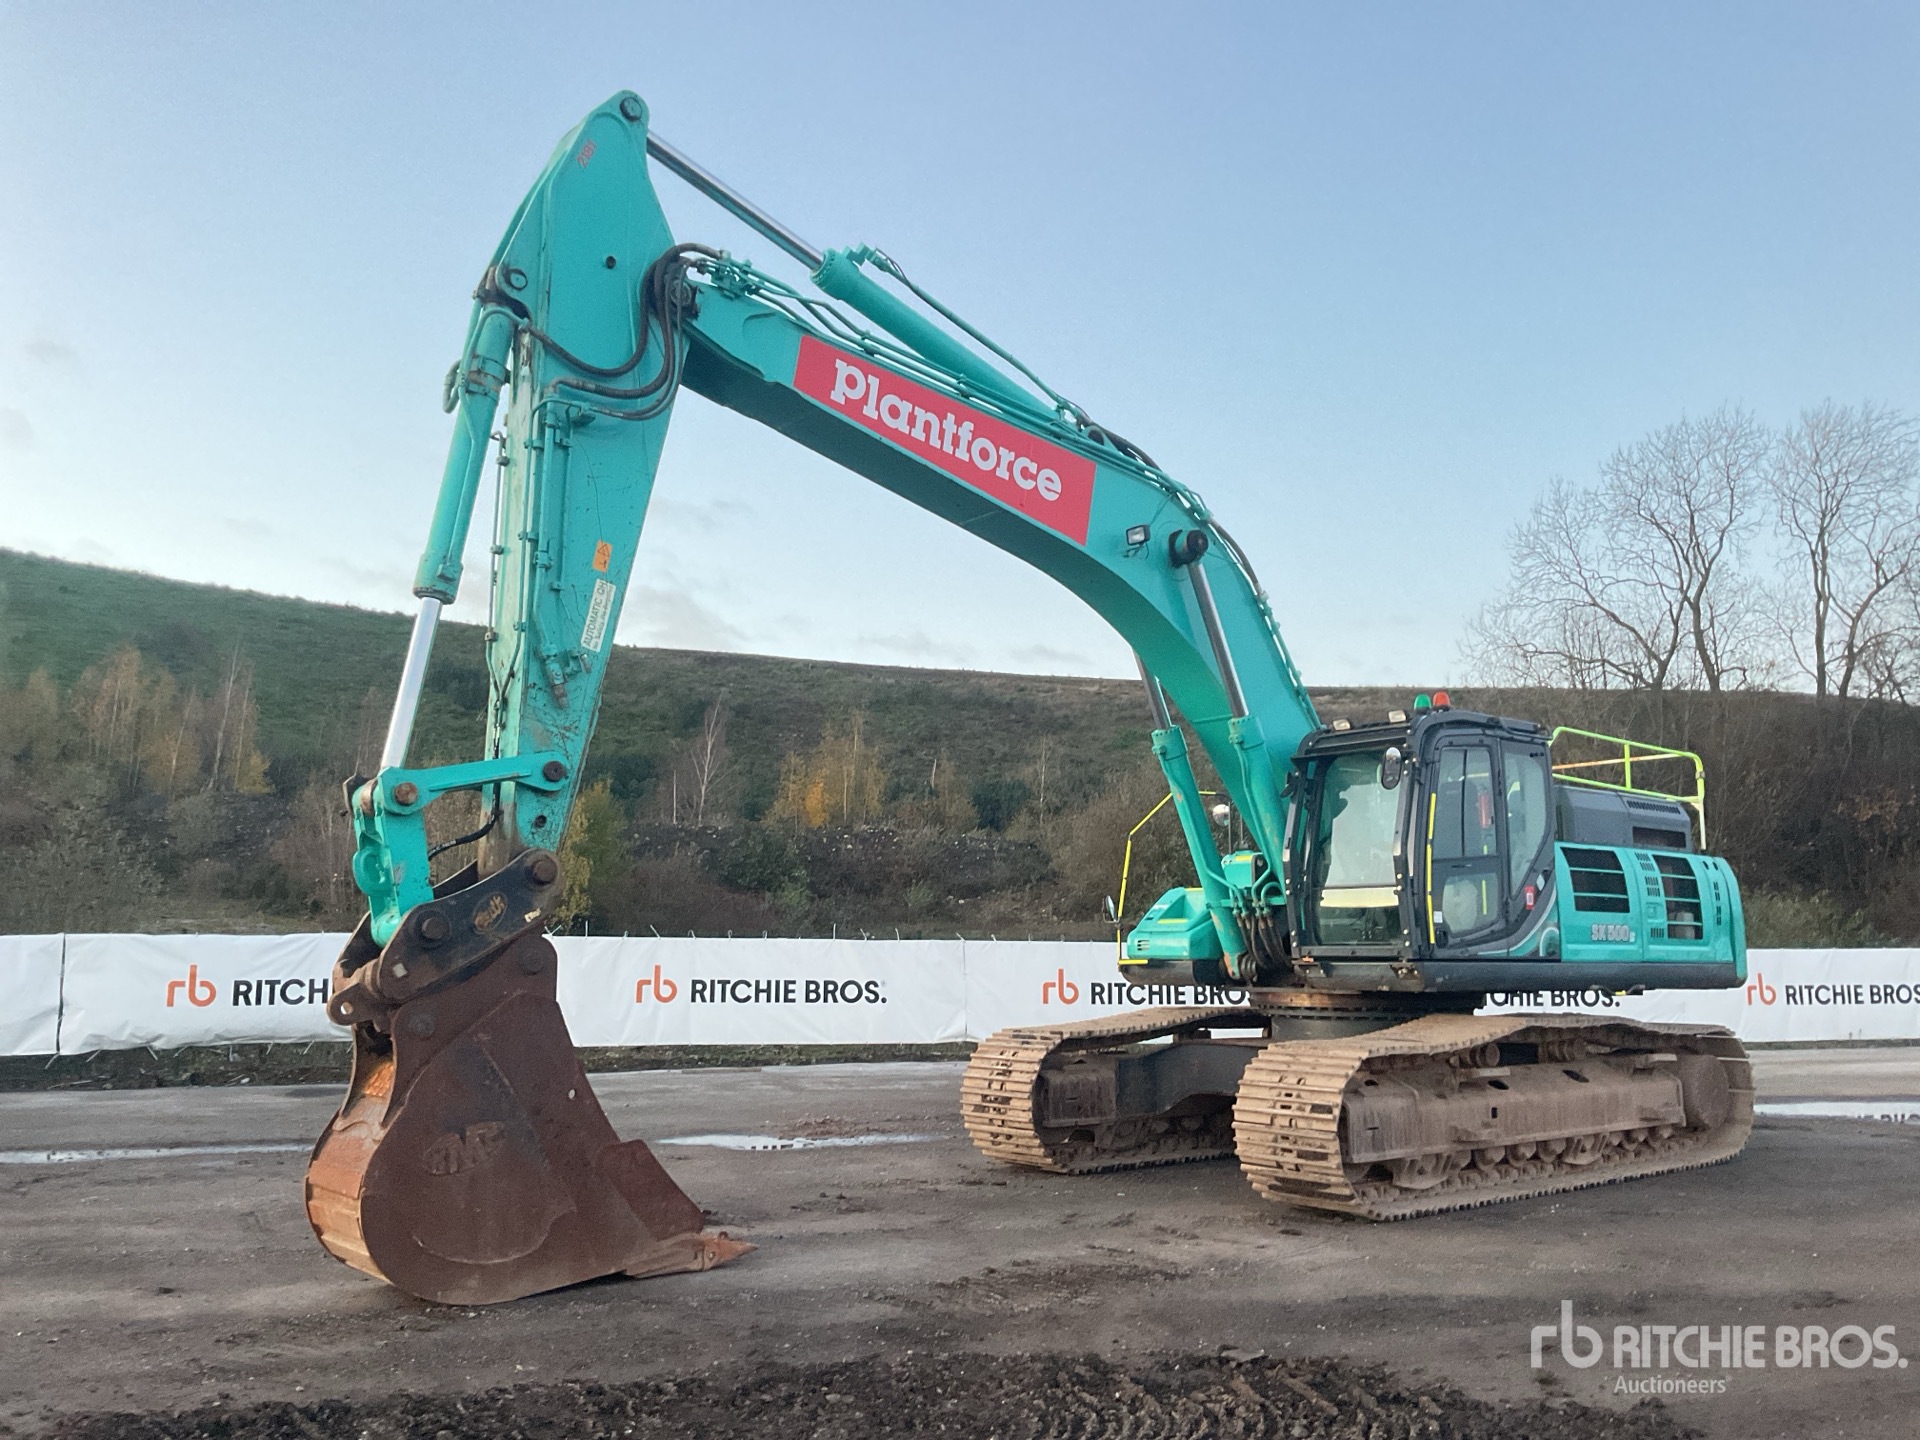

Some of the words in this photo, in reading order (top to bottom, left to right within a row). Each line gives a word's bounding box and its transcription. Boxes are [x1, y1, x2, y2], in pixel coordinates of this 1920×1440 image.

[830, 358, 1063, 502] plantforce
[582, 597, 603, 648] AUTOMATIC
[166, 964, 217, 1008] rb
[232, 978, 330, 1006] RITCH
[635, 965, 678, 1004] rb
[690, 979, 797, 1004] RITCHIE
[1042, 968, 1079, 1006] rb
[1090, 982, 1187, 1006] RITCHIE
[1193, 984, 1250, 1006] BRO
[1747, 972, 1777, 1006] rb
[1785, 984, 1865, 1006] RITCHIE
